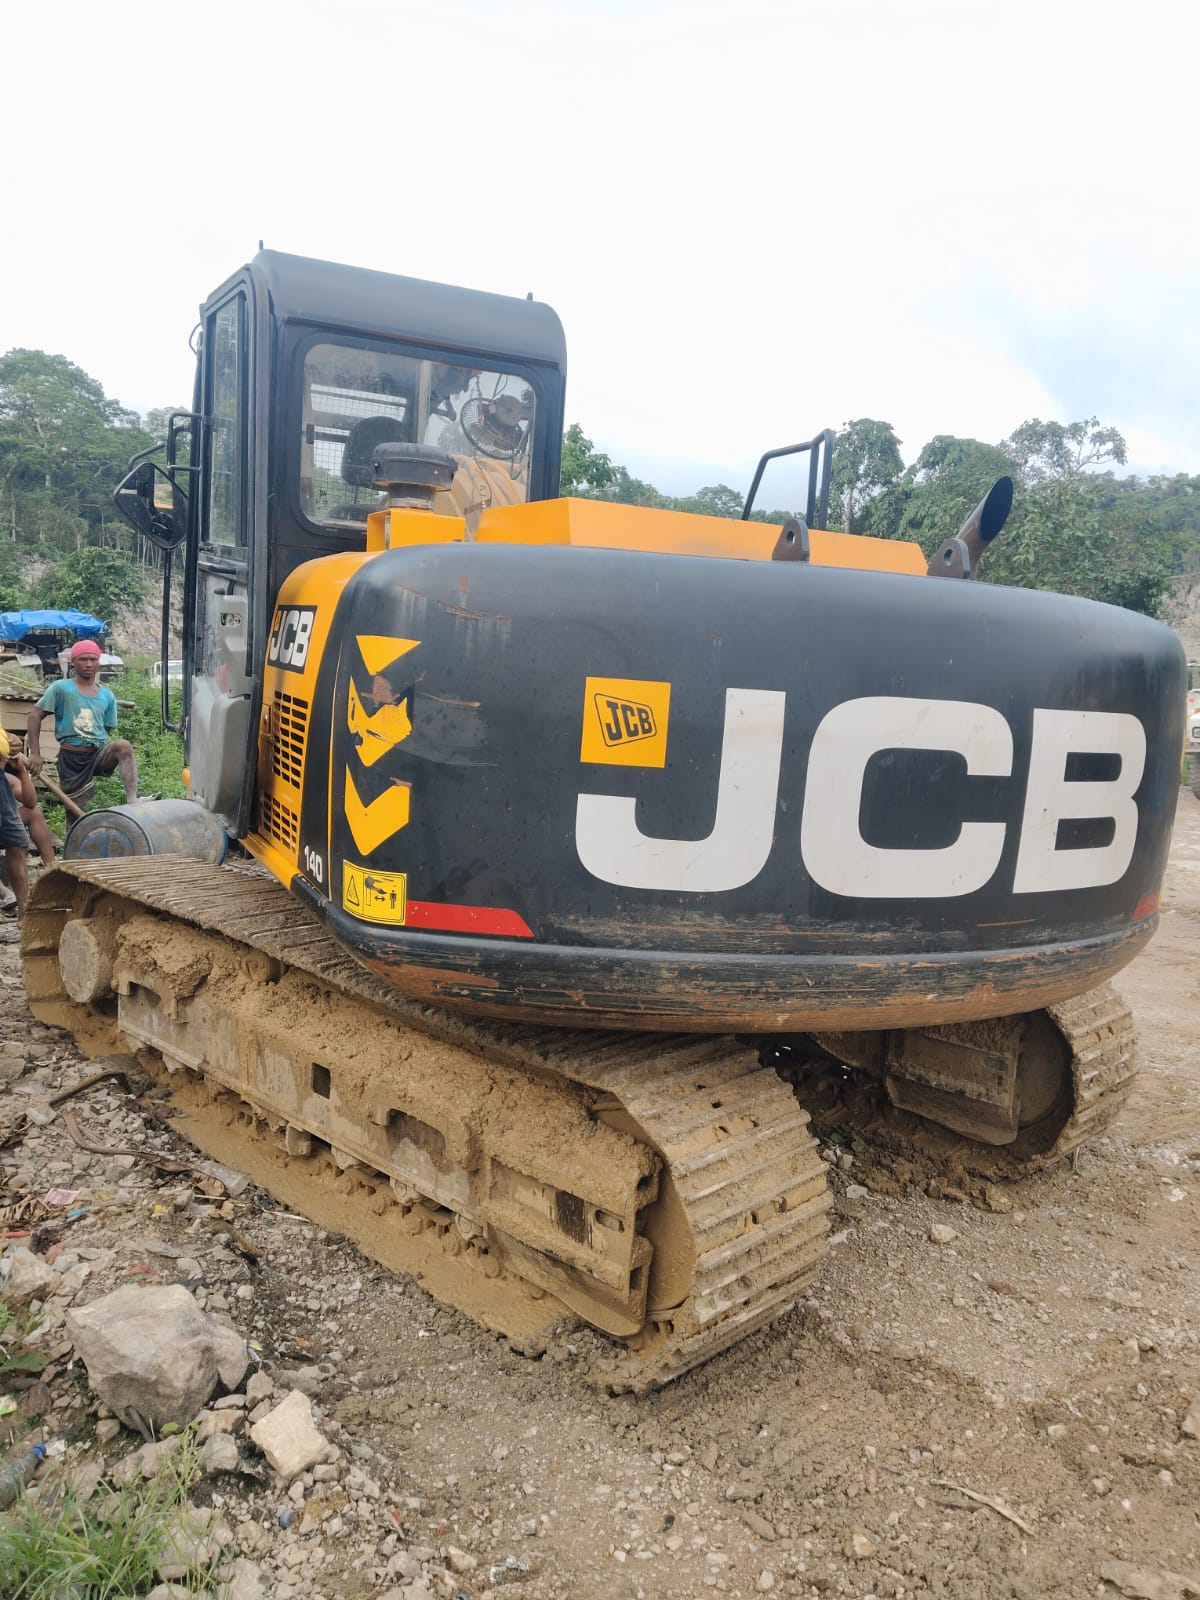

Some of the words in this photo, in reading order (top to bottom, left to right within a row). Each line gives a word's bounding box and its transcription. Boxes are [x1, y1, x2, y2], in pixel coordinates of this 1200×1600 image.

[269, 610, 314, 667] JCB
[605, 700, 652, 741] JCB
[575, 687, 1147, 899] JCB
[304, 845, 323, 884] 140
